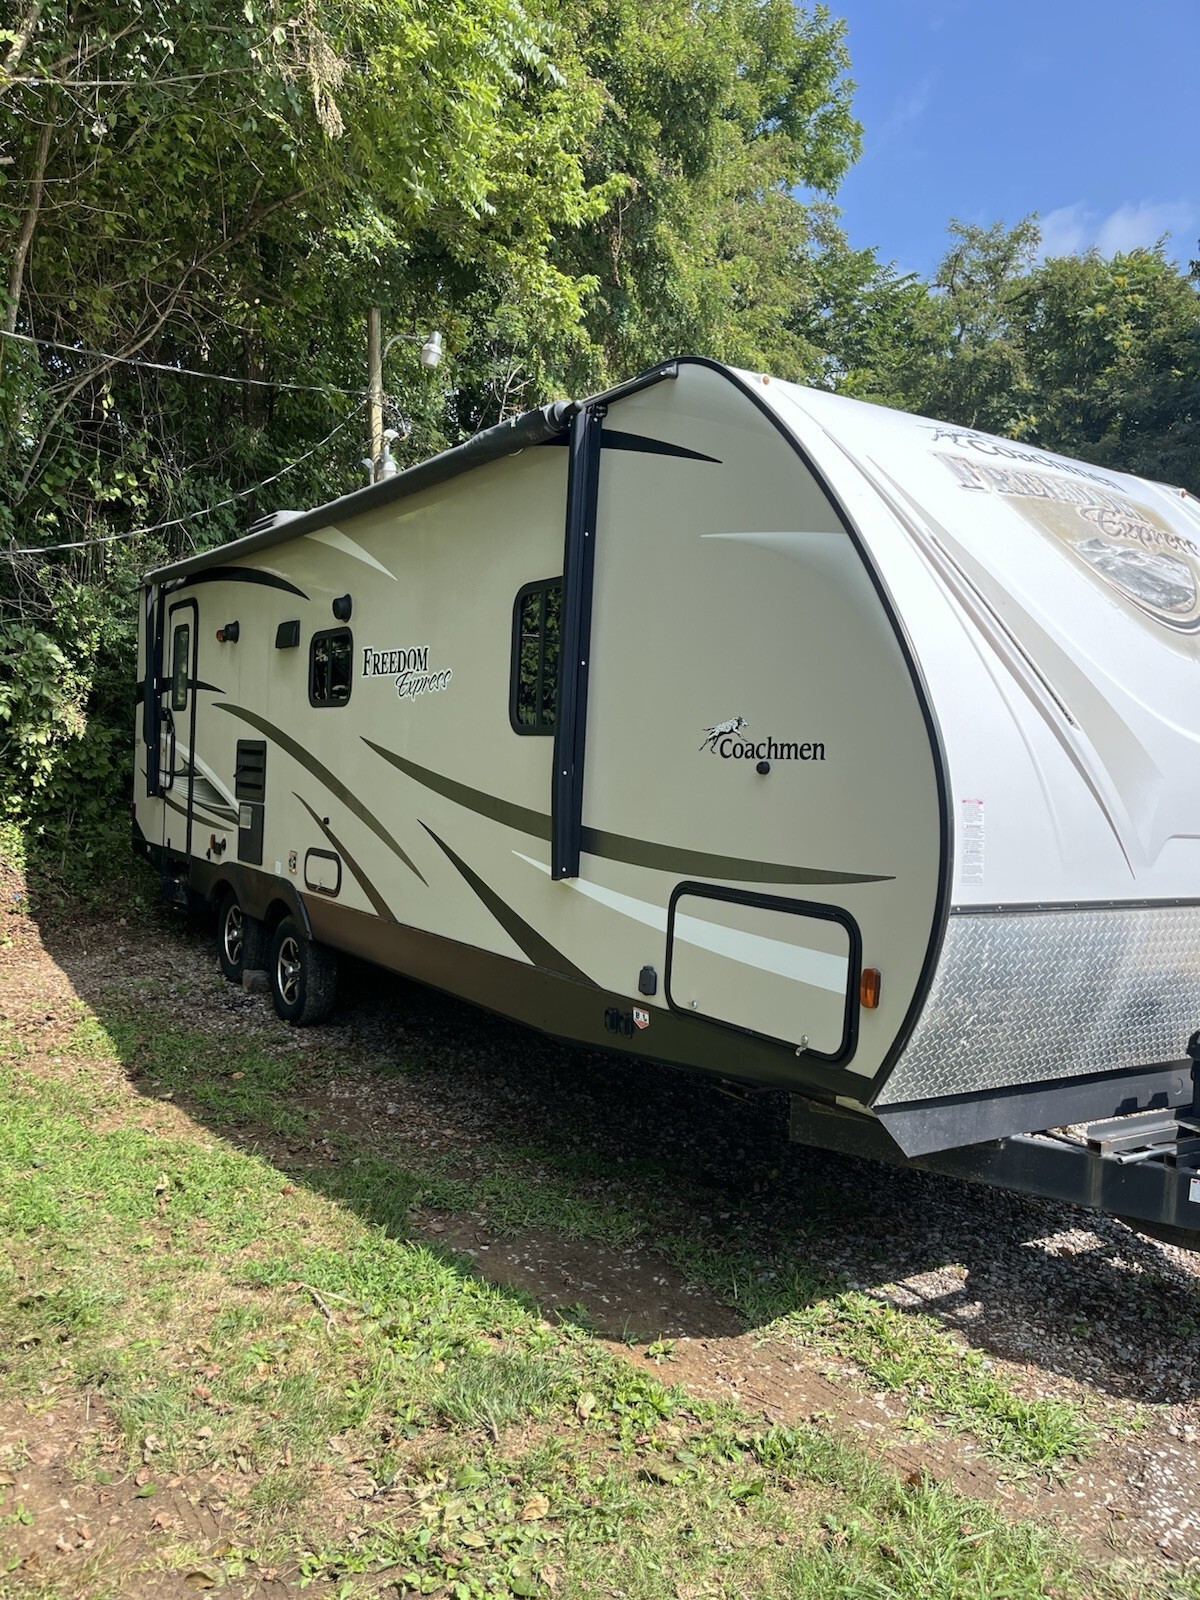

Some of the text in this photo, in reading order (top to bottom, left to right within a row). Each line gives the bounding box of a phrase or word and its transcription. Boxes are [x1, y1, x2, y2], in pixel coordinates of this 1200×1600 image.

[967, 439, 1128, 493] Coachmen
[1078, 504, 1200, 557] Express
[362, 647, 428, 676] FREEDOM
[395, 670, 451, 699] Express
[720, 736, 825, 760] Coachmen
